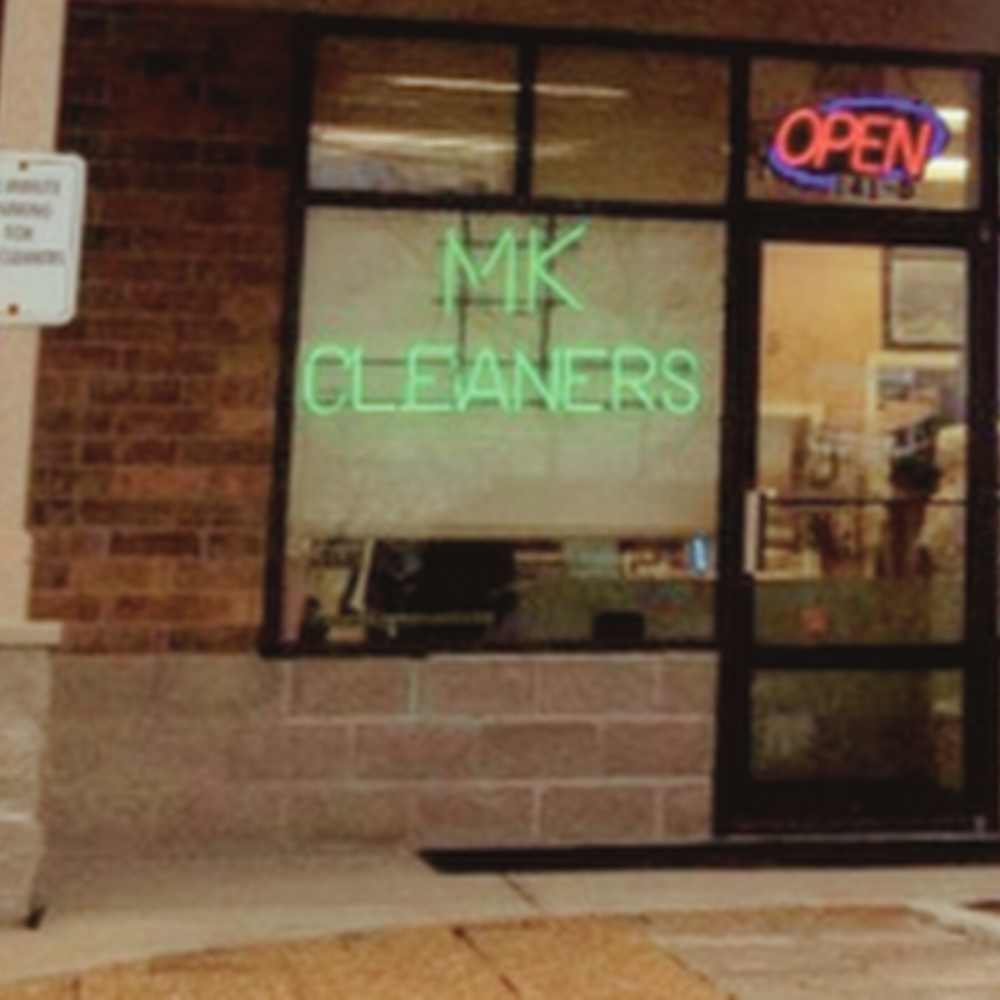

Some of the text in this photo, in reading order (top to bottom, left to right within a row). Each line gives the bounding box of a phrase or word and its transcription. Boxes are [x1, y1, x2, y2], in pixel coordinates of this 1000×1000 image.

[774, 106, 933, 178] OPEN
[442, 216, 590, 315] MK
[302, 343, 701, 416] CLEANERS
